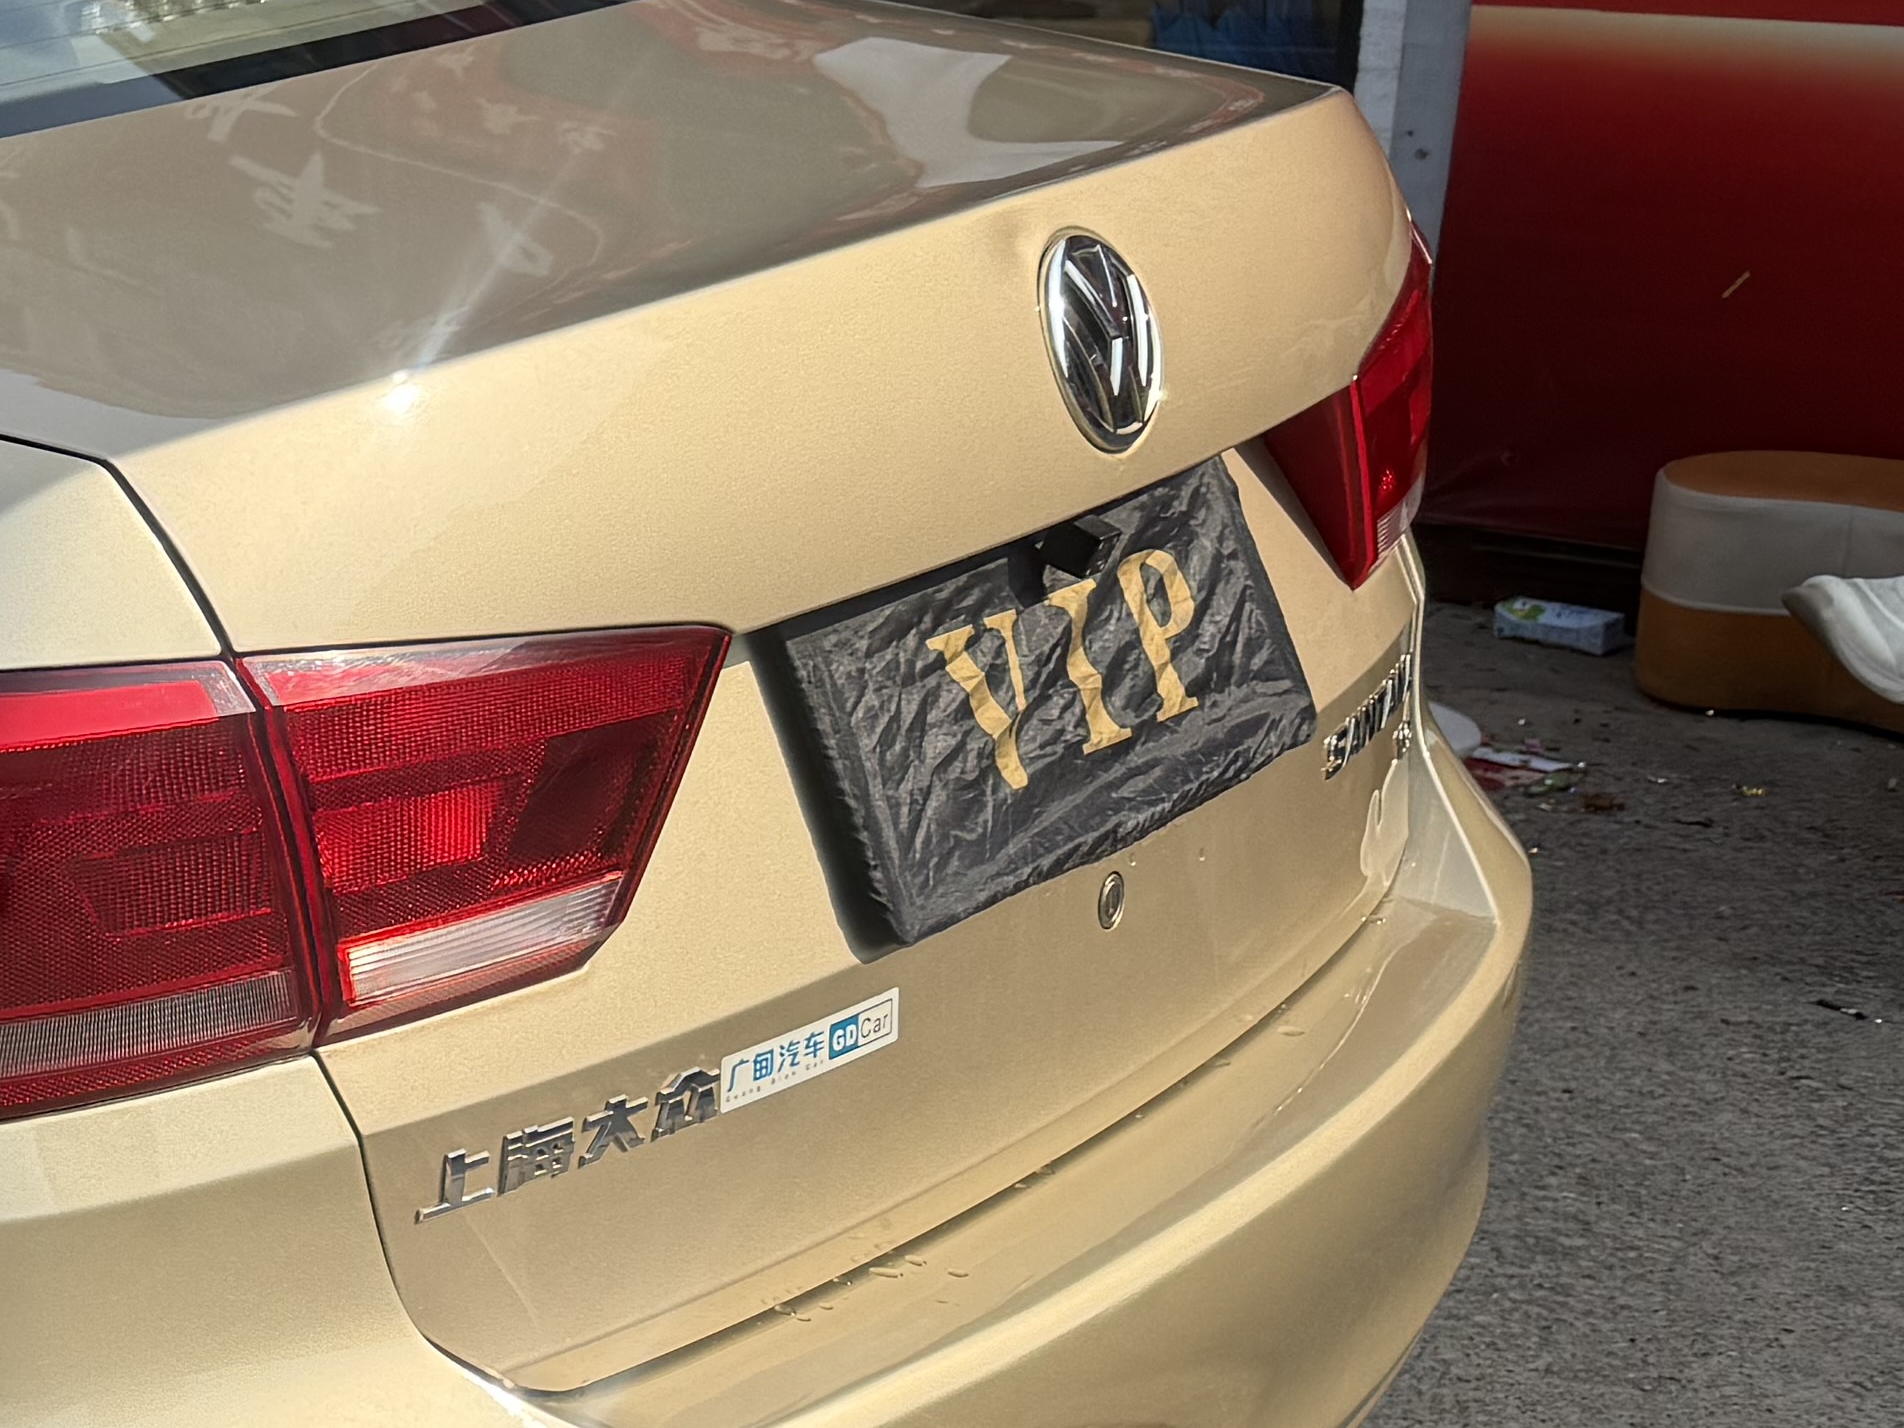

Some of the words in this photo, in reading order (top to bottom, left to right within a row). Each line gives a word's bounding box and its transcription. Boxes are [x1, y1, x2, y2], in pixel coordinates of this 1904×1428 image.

[929, 548, 1198, 790] VIP
[727, 1030, 825, 1093] 广甸汽车
[414, 1065, 721, 1225] 上海大众
